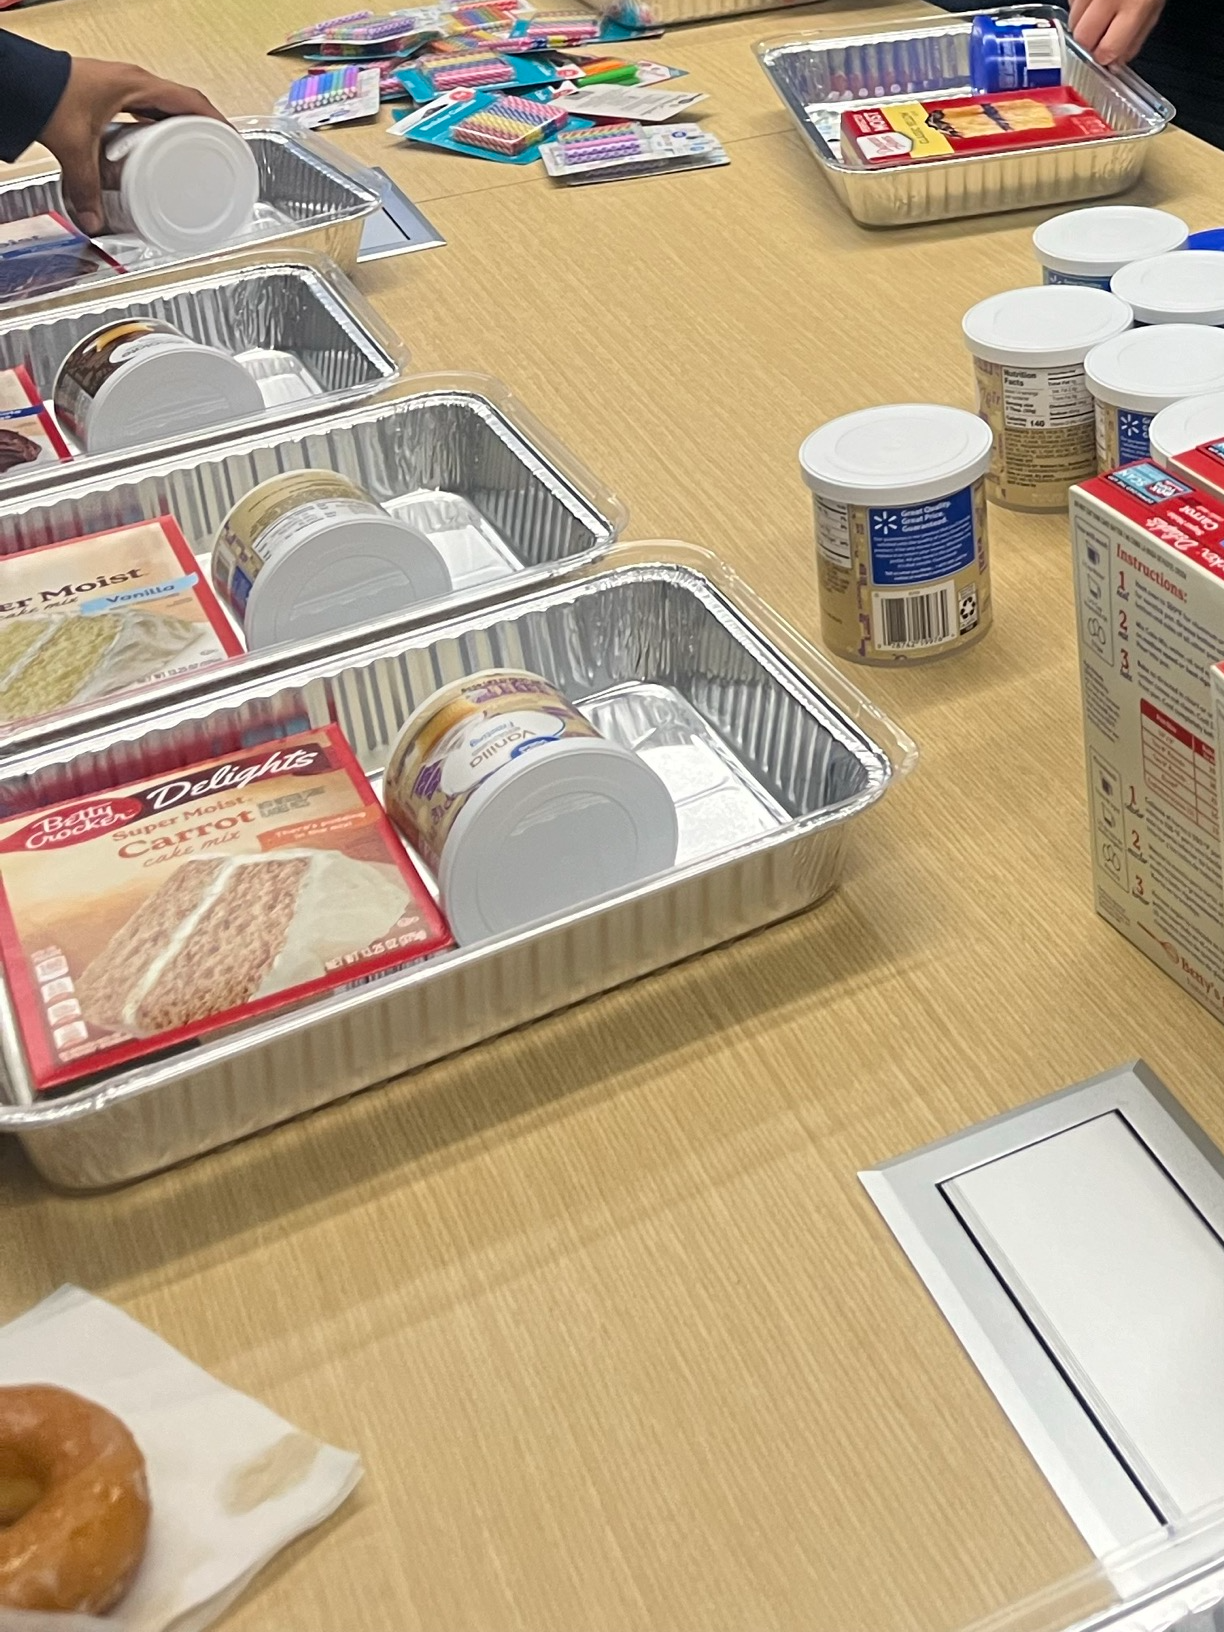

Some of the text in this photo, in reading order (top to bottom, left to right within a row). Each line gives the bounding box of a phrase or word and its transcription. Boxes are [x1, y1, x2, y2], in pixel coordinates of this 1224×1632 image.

[1030, 419, 1046, 428] 140
[1179, 505, 1219, 531] Carrot
[38, 567, 143, 602] Moist
[1116, 543, 1188, 603] Instructions:
[106, 584, 175, 604] Vanilla
[469, 729, 536, 768] Vanilla
[147, 749, 320, 811] Delights
[25, 809, 135, 849] Crocker
[32, 798, 114, 834] Betty
[112, 814, 179, 843] Super
[184, 795, 245, 819] Moist
[118, 809, 256, 859] Carrot
[143, 829, 241, 868] cake mix
